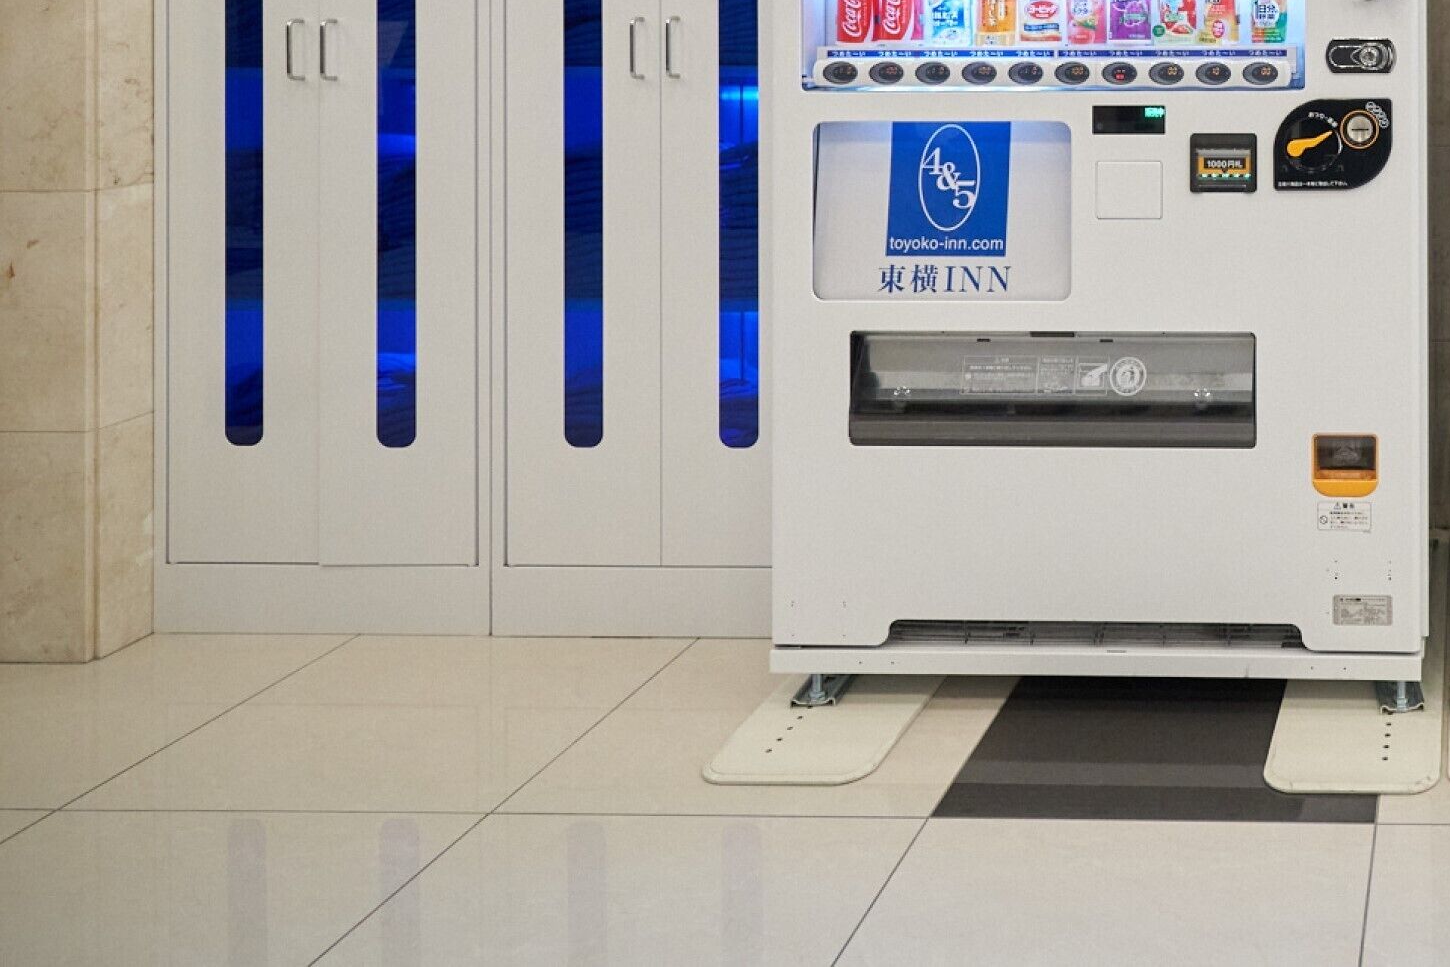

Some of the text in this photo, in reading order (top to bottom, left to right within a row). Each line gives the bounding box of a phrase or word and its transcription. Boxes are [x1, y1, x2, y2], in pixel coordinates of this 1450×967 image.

[922, 147, 976, 210] 4&5
[889, 235, 1004, 253] toyoko-inn.com
[877, 264, 1012, 294] 東横INN
